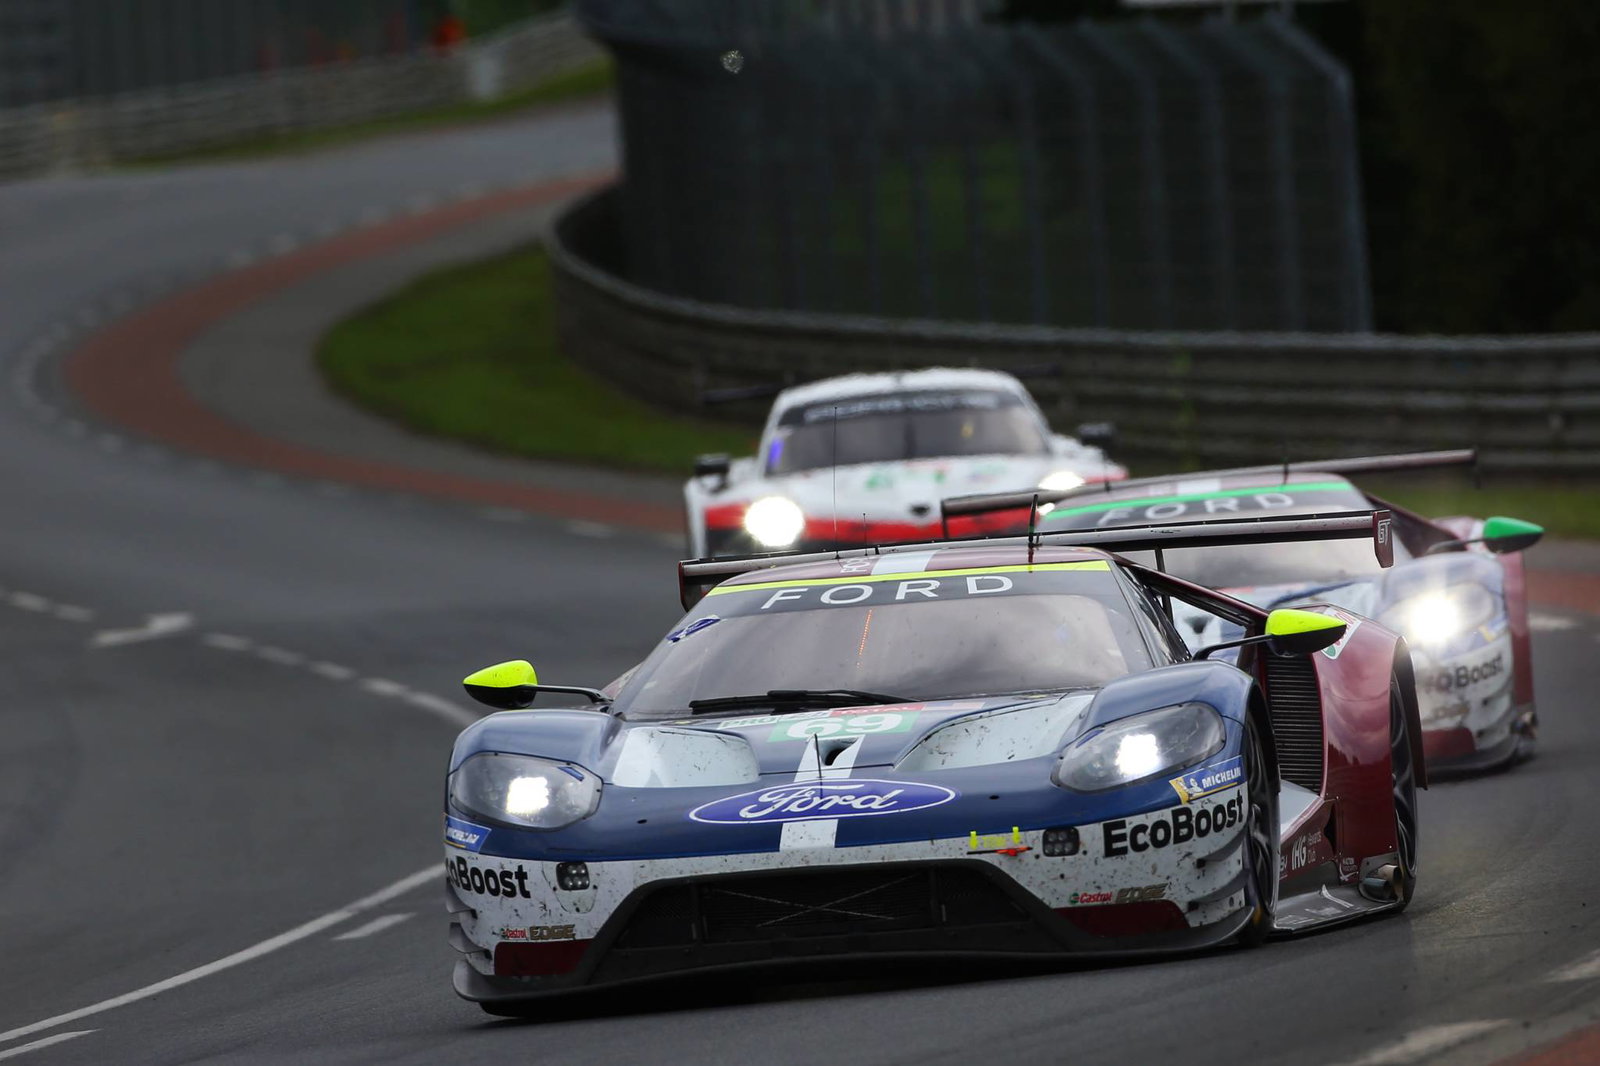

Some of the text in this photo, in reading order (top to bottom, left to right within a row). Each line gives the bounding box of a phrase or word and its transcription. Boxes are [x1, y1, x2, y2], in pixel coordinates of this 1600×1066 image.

[1096, 492, 1294, 528] FORD
[1378, 518, 1392, 545] GT
[760, 574, 1014, 610] FORD
[786, 712, 903, 738] 69
[1202, 766, 1242, 789] MICHELIN
[738, 783, 904, 819] Ford
[1102, 789, 1244, 858] EcoBoost
[1291, 835, 1307, 871] IHG
[1080, 891, 1113, 904] Castrol
